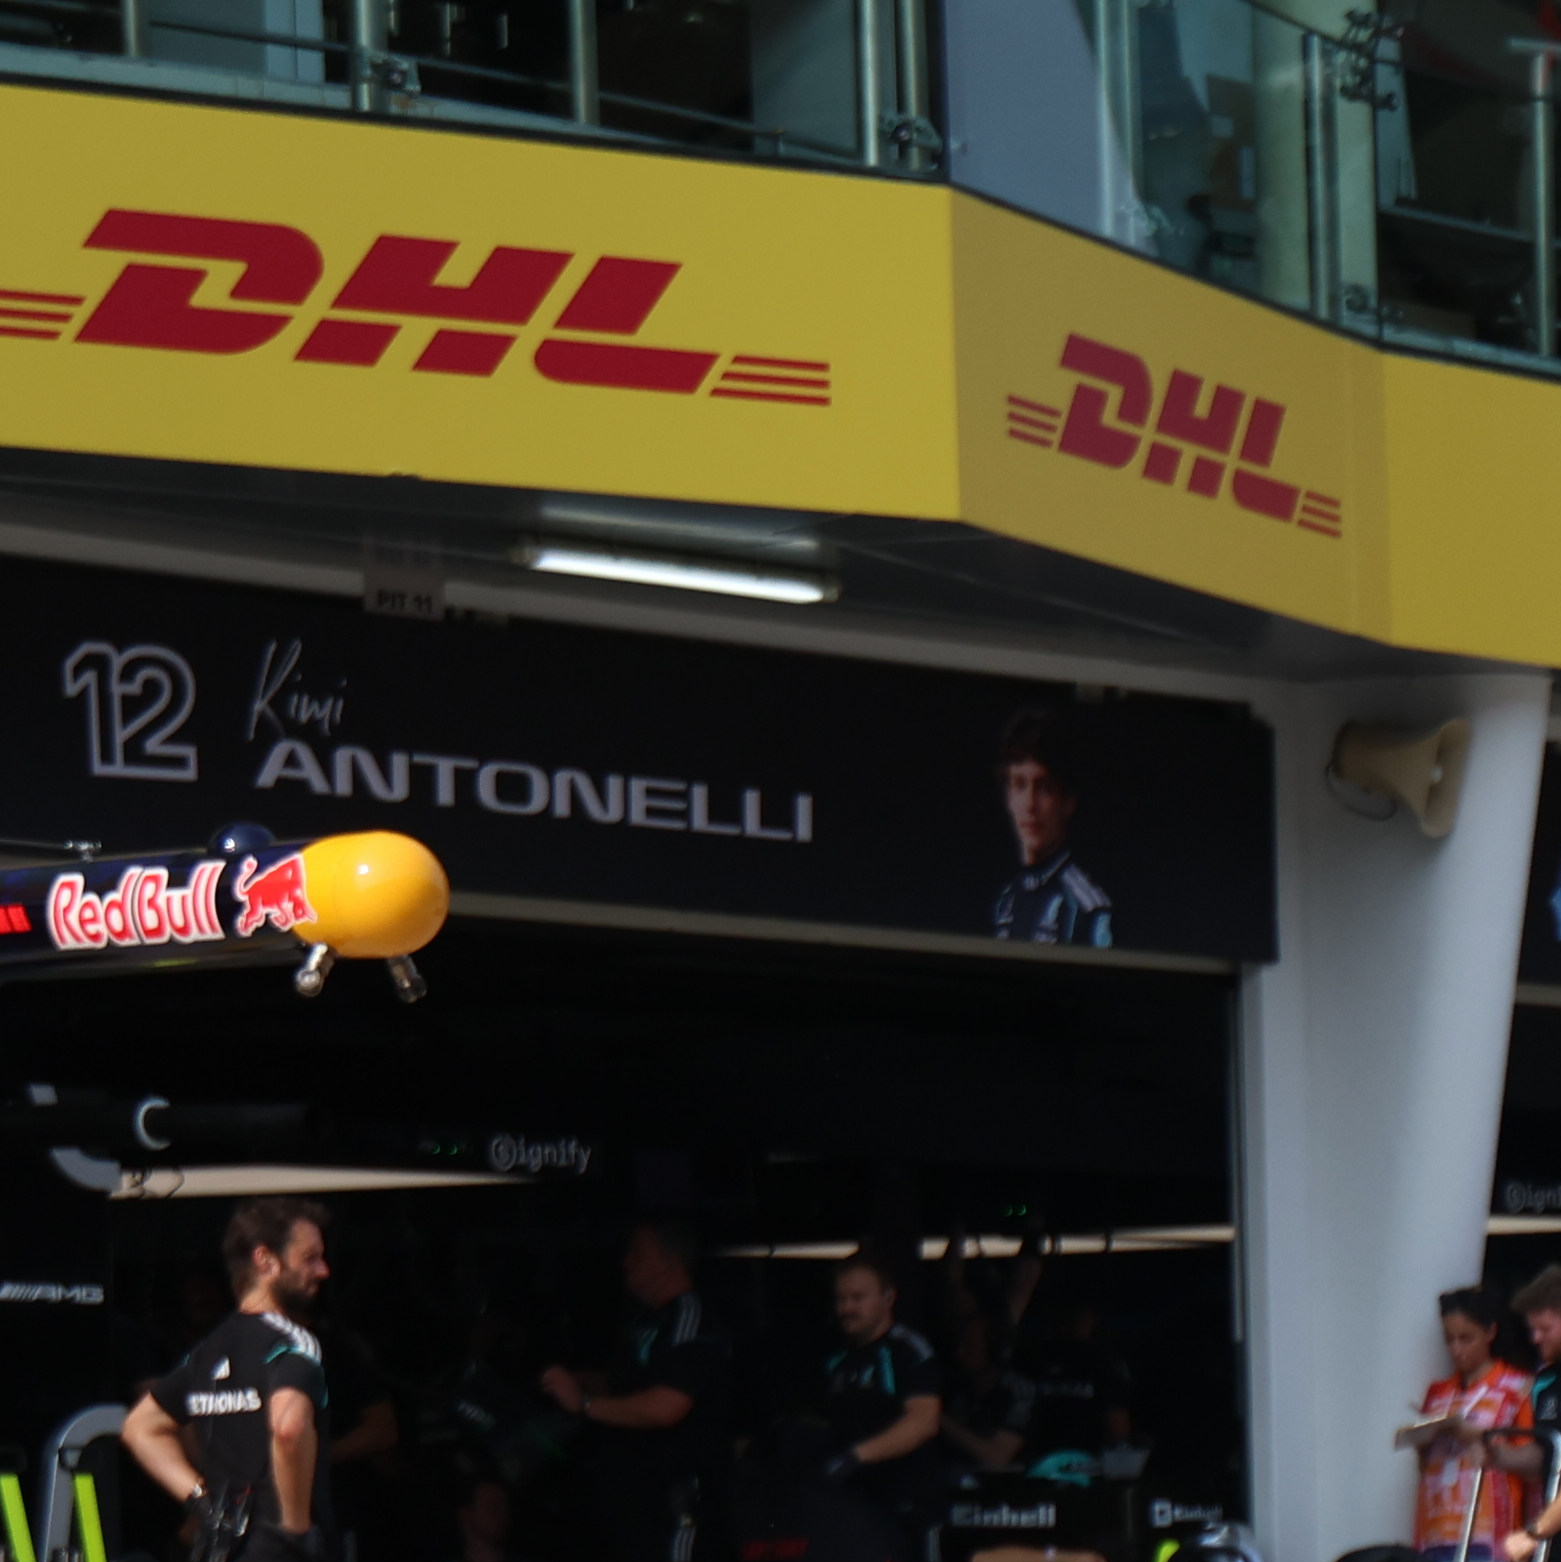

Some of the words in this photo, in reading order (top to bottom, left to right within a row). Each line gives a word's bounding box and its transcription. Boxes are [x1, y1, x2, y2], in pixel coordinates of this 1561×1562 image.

[75, 209, 719, 395] DHL
[1058, 332, 1301, 522] DHL
[377, 589, 404, 610] PIT
[64, 641, 198, 782] 12
[248, 639, 348, 742] Kimi
[255, 738, 815, 844] ANTONELLI
